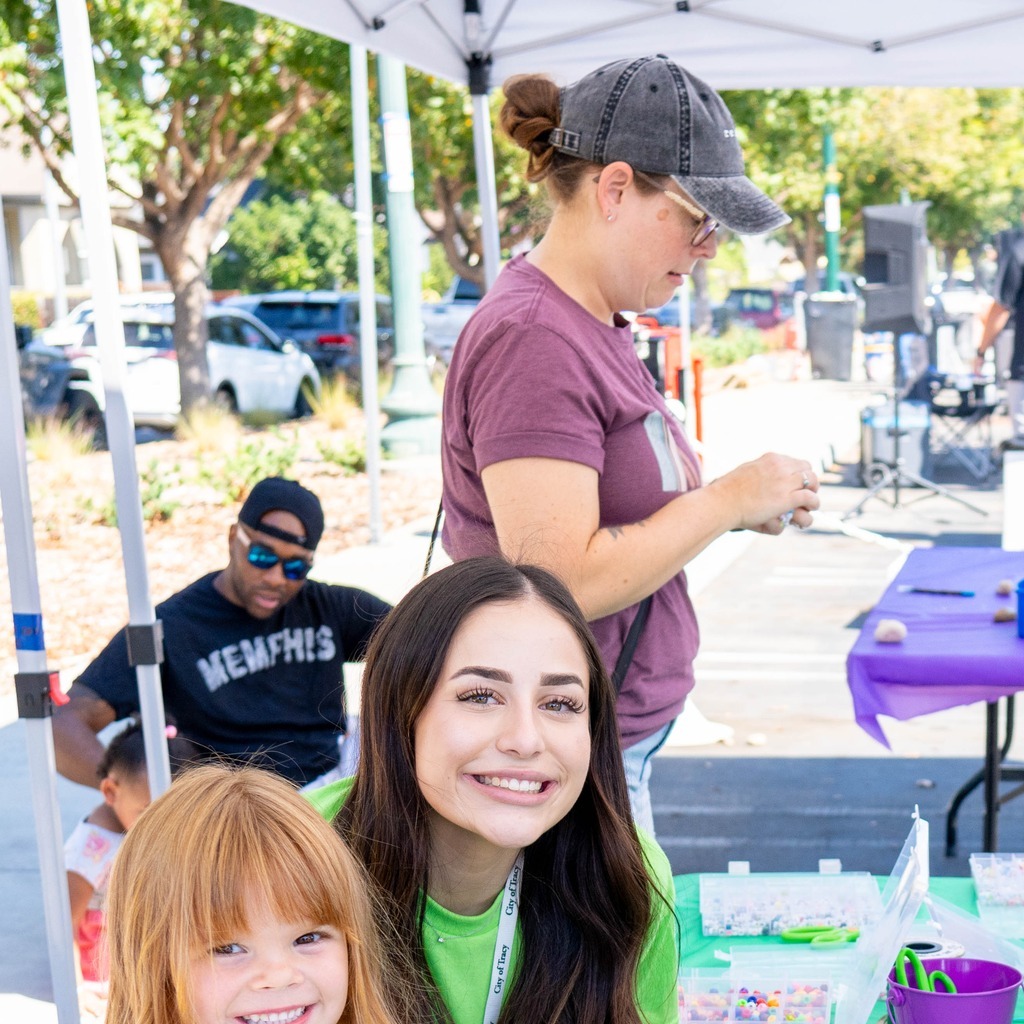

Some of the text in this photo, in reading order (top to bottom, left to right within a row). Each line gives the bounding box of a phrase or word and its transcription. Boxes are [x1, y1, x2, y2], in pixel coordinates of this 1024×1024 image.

[197, 625, 336, 692] MEMPHIS
[505, 866, 521, 916] City of Tracy
[494, 944, 509, 994] City of Tracy
